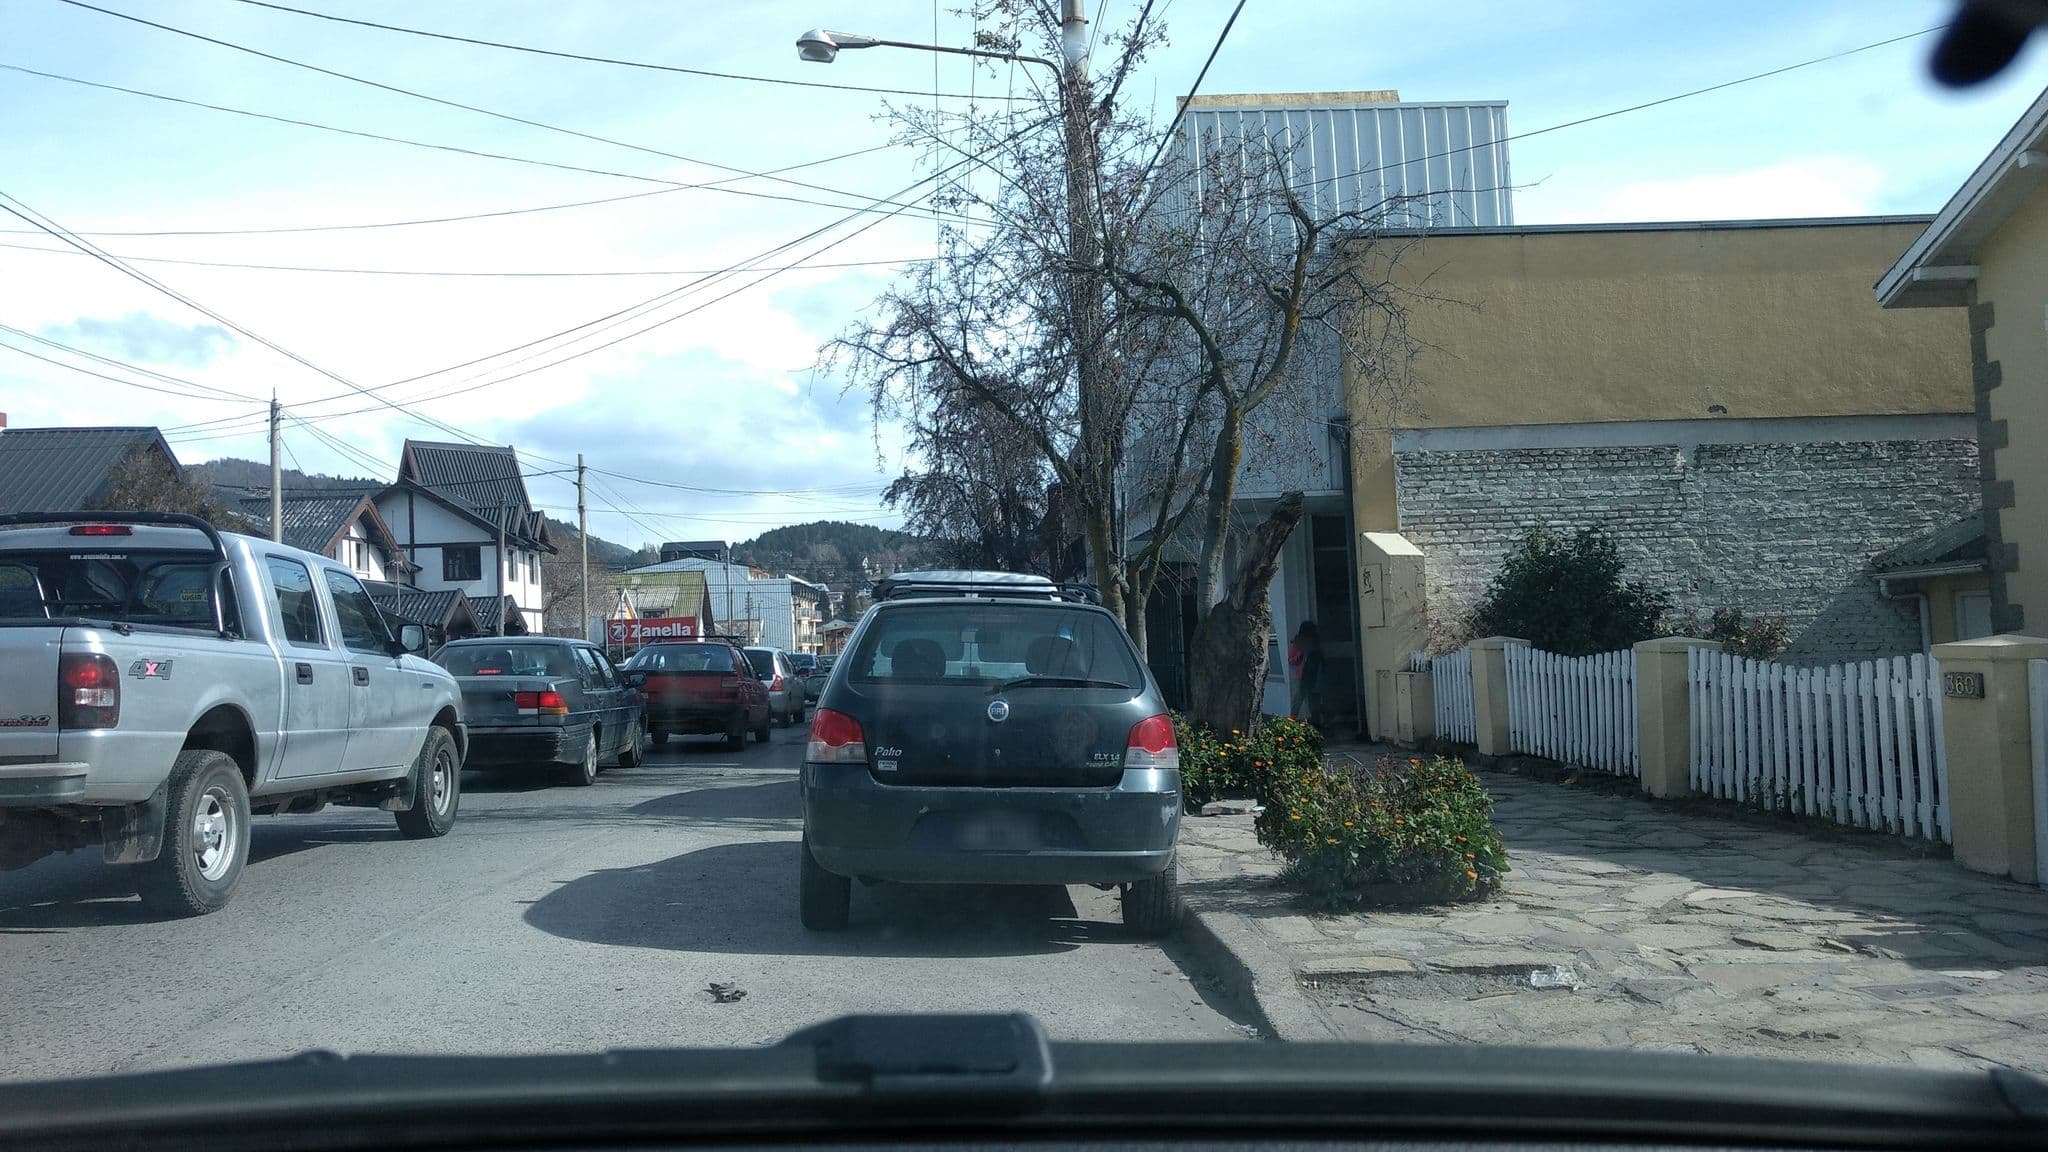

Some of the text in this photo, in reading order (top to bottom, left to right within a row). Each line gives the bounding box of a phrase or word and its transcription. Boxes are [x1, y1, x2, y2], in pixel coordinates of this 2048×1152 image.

[630, 622, 691, 638] Zanella
[128, 658, 173, 680] 4x4
[1946, 675, 1974, 695] 360
[874, 746, 903, 757] Palio
